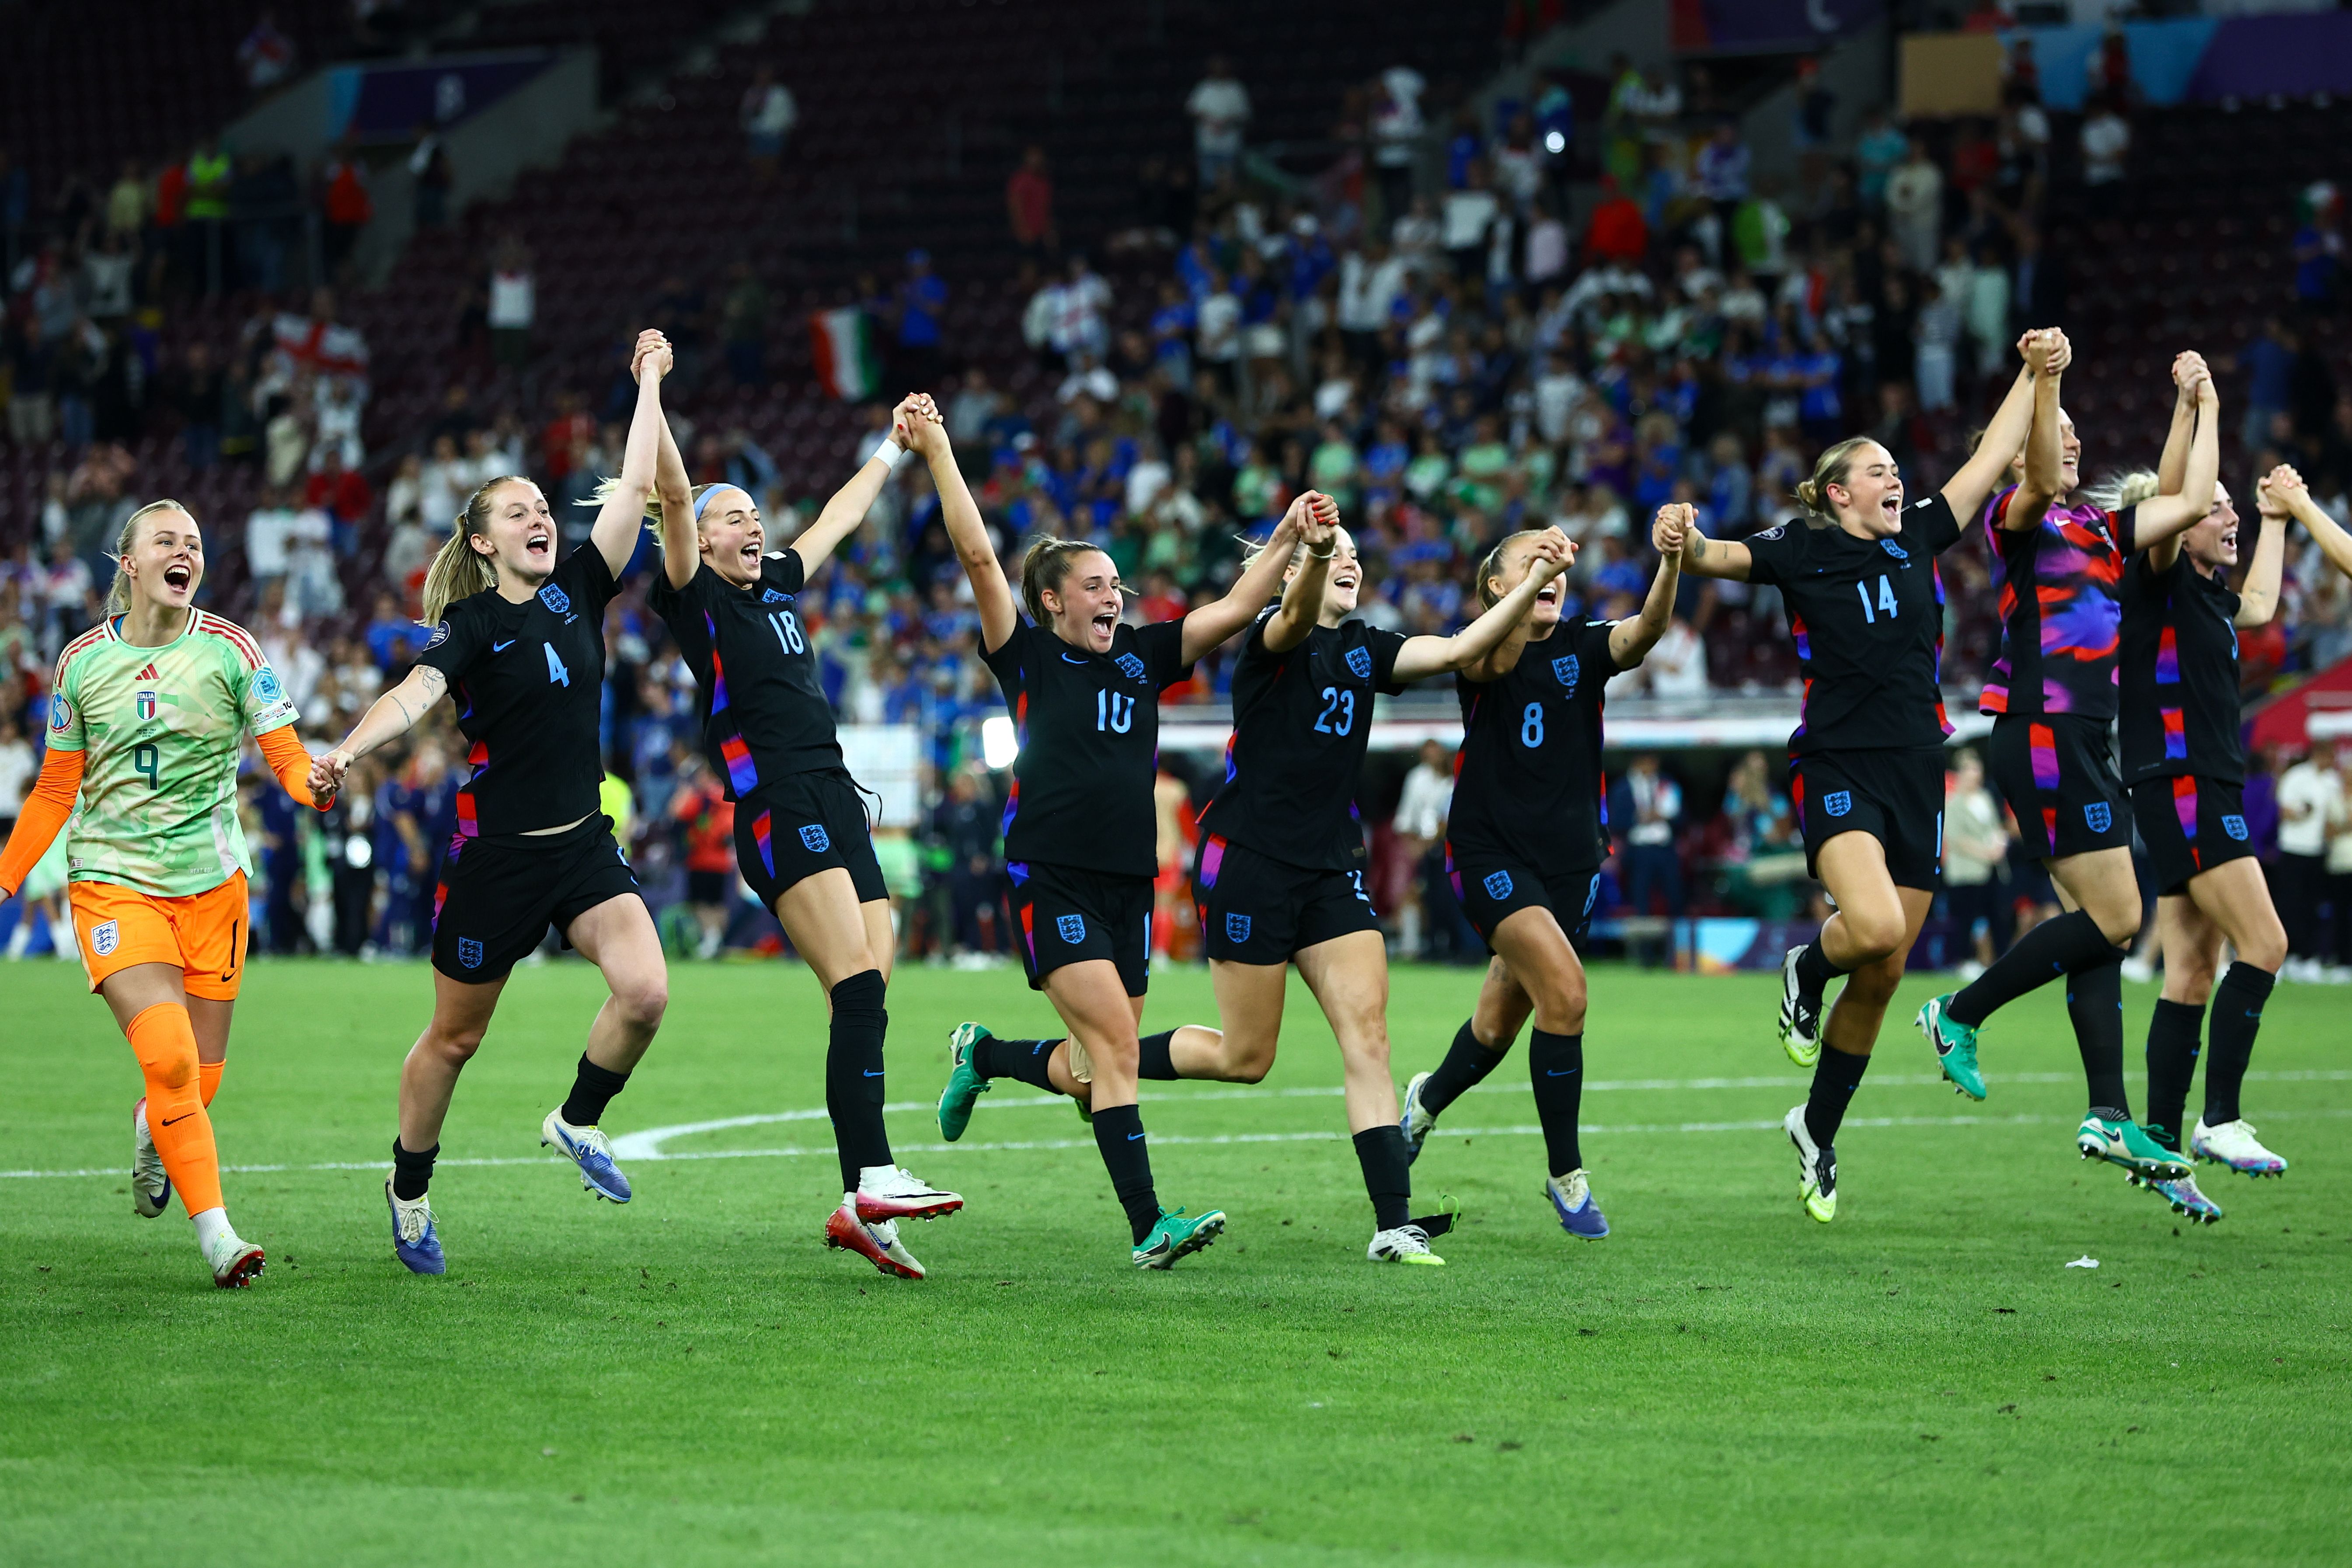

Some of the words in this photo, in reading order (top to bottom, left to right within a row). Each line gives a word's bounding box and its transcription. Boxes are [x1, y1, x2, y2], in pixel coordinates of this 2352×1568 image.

[1857, 574, 1898, 624] 14
[768, 610, 804, 655] 18
[544, 642, 569, 688] 4
[256, 707, 284, 722] FOUNDATION
[1098, 688, 1135, 734] 10
[1314, 687, 1354, 737] 23
[1522, 702, 1544, 748] 8
[134, 744, 158, 790] 9
[1583, 873, 1600, 917] 8
[230, 918, 238, 968] 1
